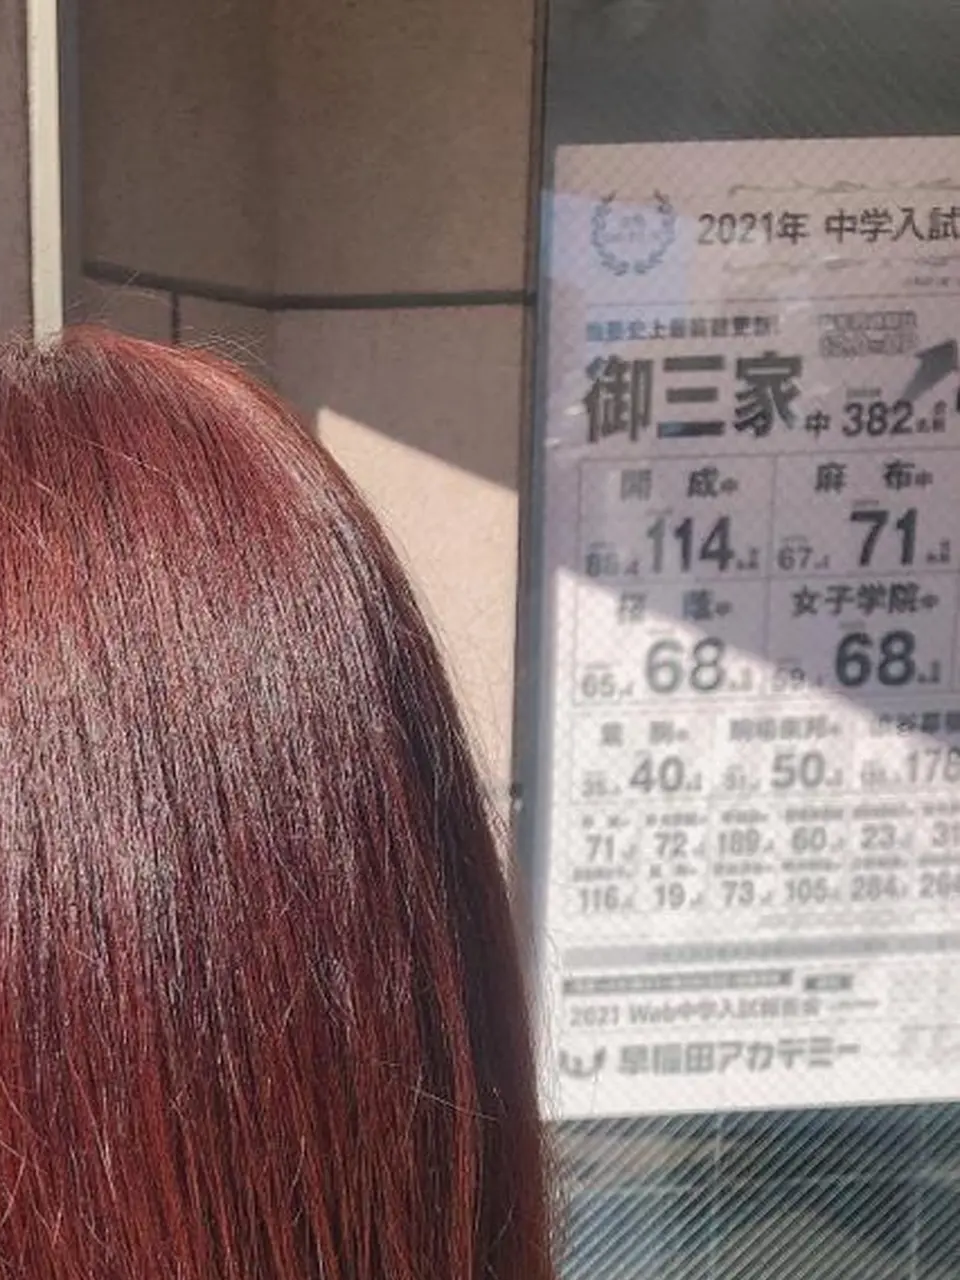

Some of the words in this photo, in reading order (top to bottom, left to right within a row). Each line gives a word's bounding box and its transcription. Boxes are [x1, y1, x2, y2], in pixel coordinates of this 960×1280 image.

[697, 211, 809, 244] 2021年
[584, 352, 802, 443] 御三家
[842, 401, 913, 437] 382
[646, 515, 734, 573] 114
[850, 507, 917, 567] 71
[645, 637, 724, 694] 68
[836, 630, 915, 687] 68
[630, 755, 684, 793] 40
[771, 752, 825, 788] 50
